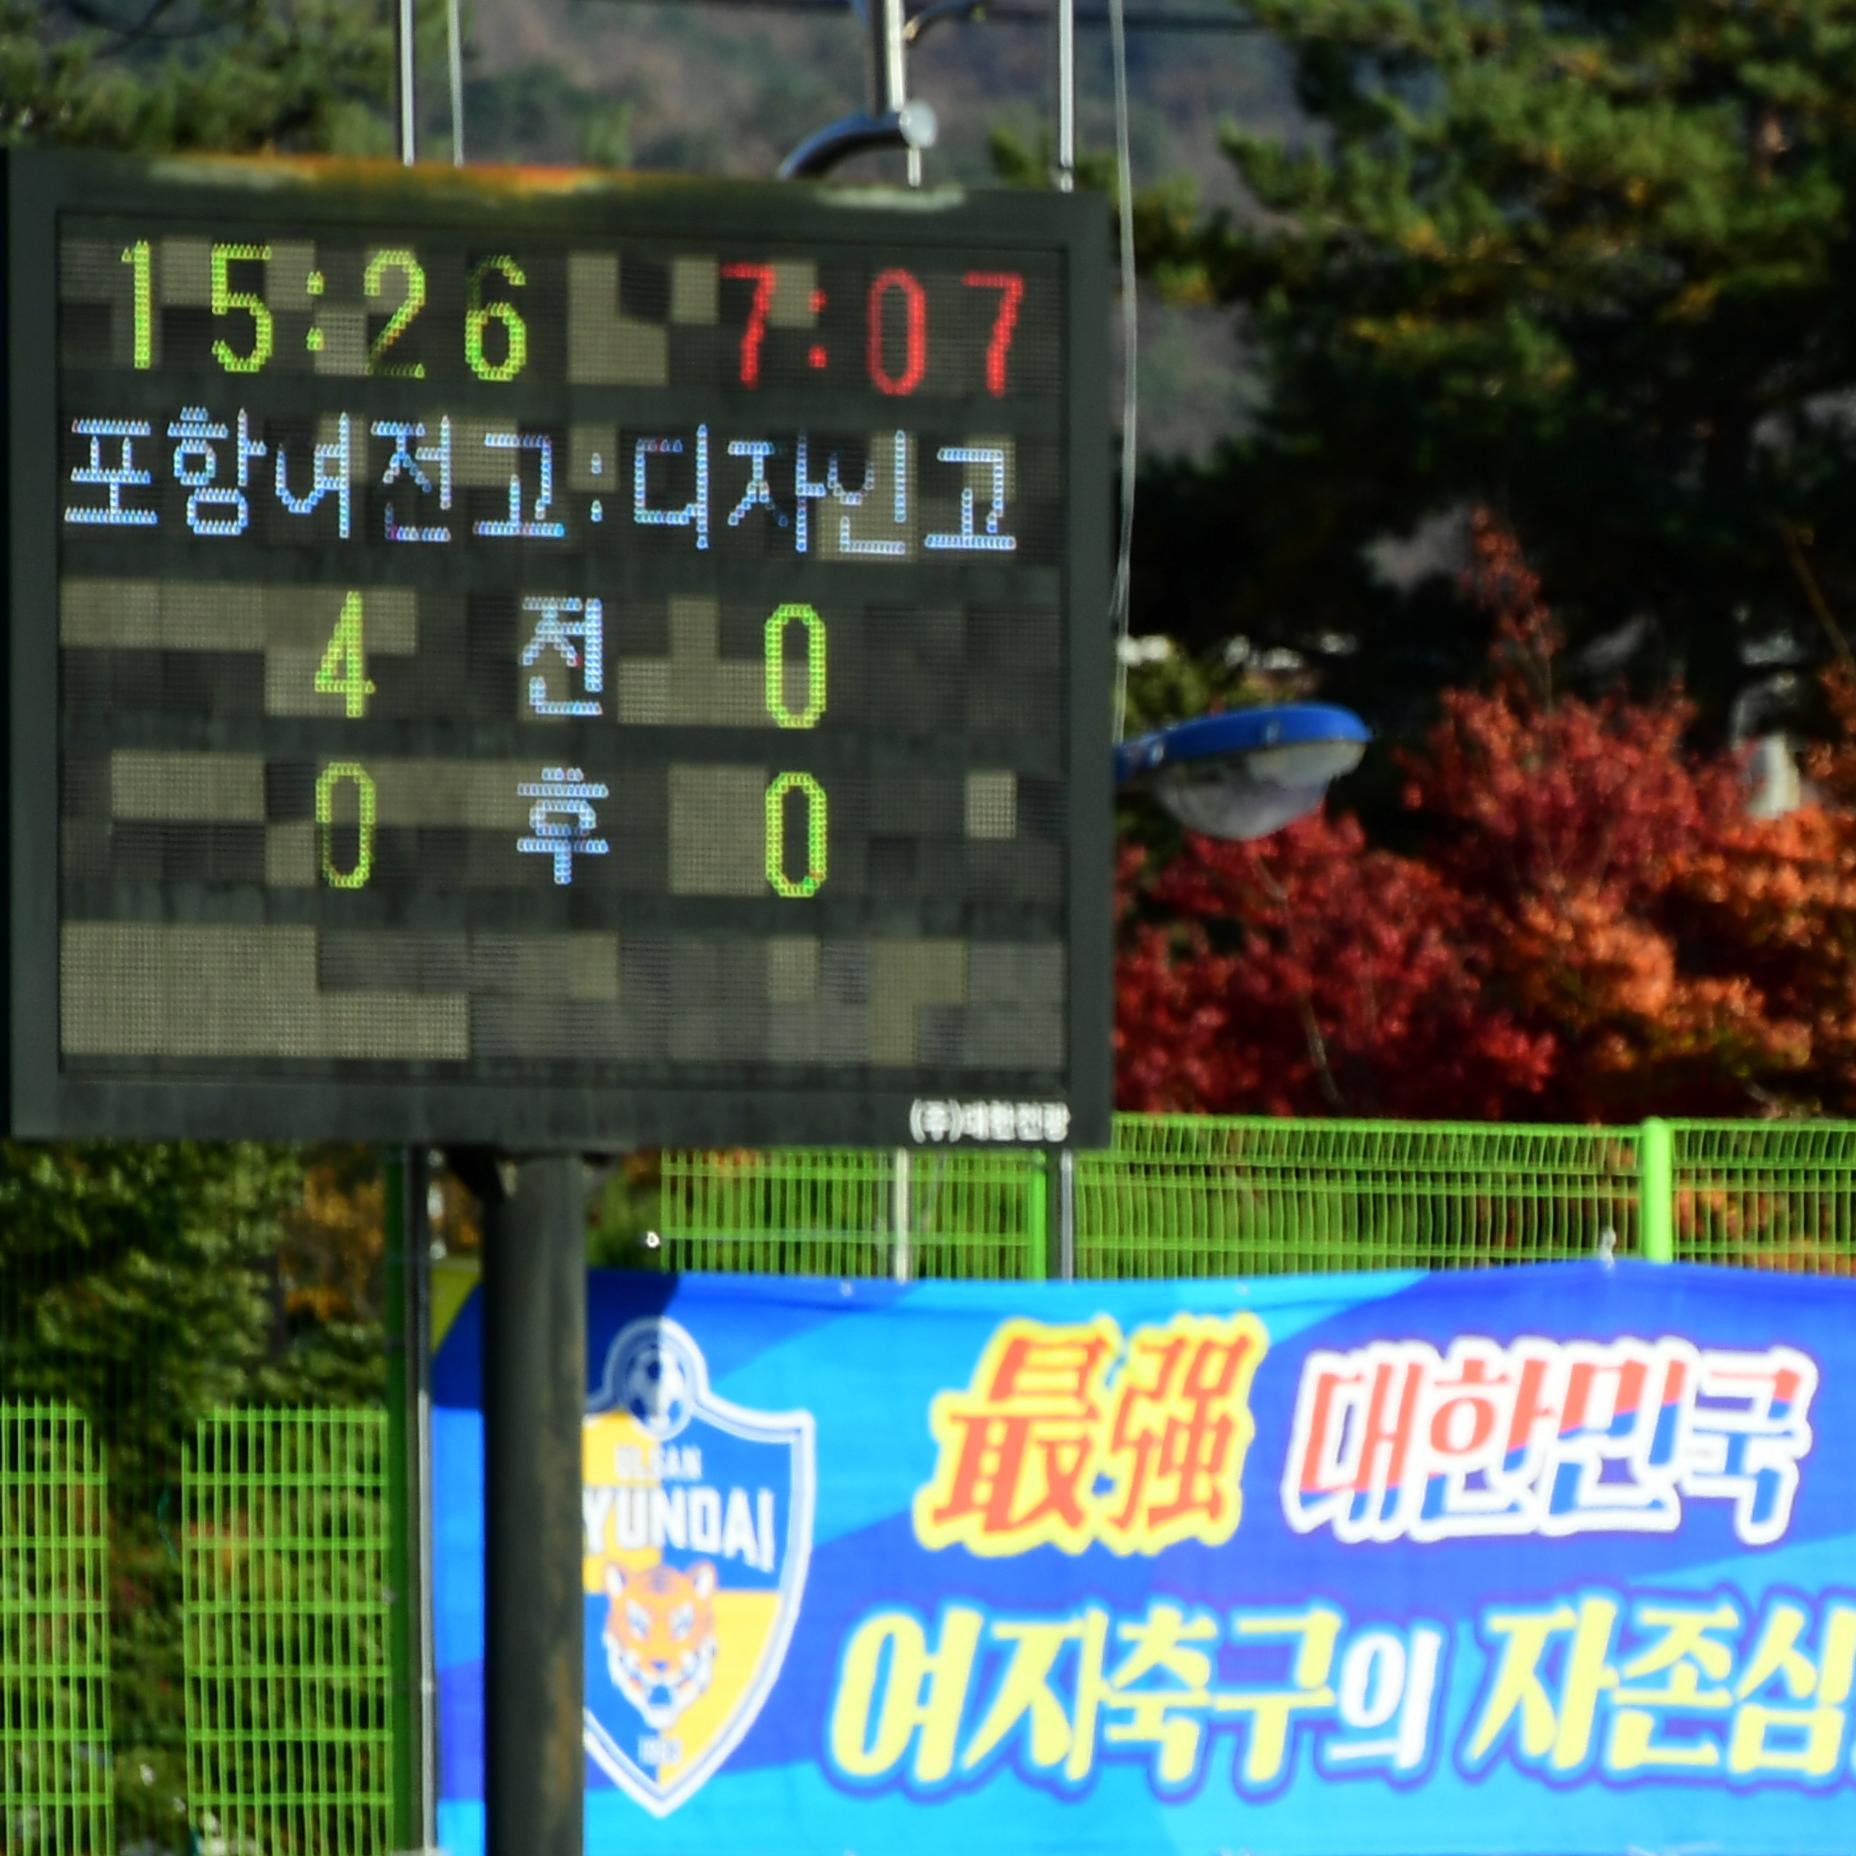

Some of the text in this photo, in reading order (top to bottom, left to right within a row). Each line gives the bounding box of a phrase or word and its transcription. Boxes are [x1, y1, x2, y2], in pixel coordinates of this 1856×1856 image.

[121, 239, 1023, 397] 15:26 7:07
[314, 590, 826, 729] 4 전 0
[315, 762, 827, 897] 0 후 0
[1287, 1338, 1815, 1543] 대한민국
[582, 1484, 776, 1574] YUNDAI
[832, 1608, 1440, 1781] 여자축구의
